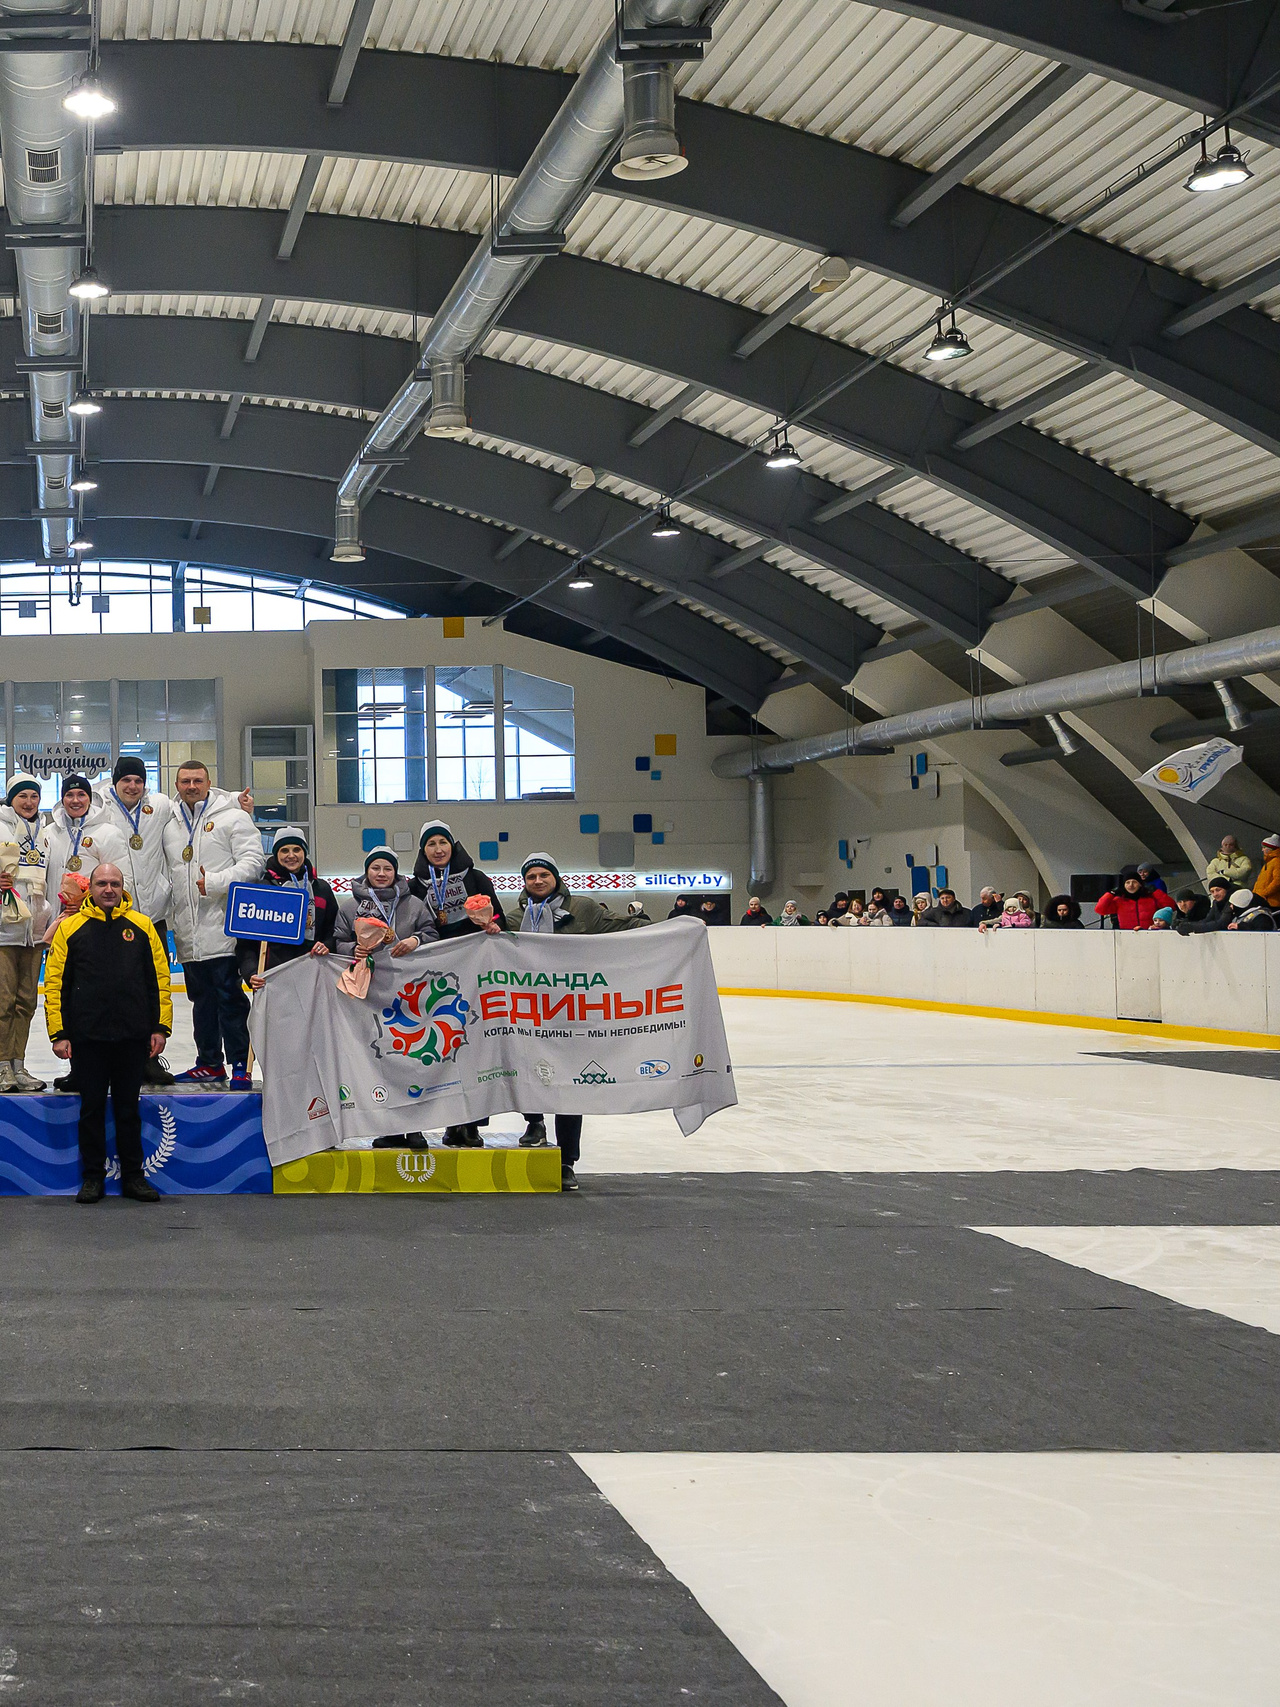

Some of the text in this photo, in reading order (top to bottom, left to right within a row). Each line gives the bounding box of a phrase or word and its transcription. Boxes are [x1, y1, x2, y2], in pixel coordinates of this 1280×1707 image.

[46, 746, 80, 755] КАФЕ
[20, 754, 108, 776] Чараўніца
[645, 873, 723, 887] silichy.by
[237, 902, 295, 924] Единые
[477, 970, 609, 991] КОМАНДА
[480, 983, 685, 1027] ЕДИНЫЕ
[483, 1026, 516, 1038] КОГДА
[517, 1027, 532, 1037] МЫ
[535, 1029, 573, 1039] ЕДИНЫ
[588, 1029, 607, 1038] МЫ
[610, 1020, 686, 1037] НЕПОБЕДИМЫ!
[402, 1154, 430, 1172] III
